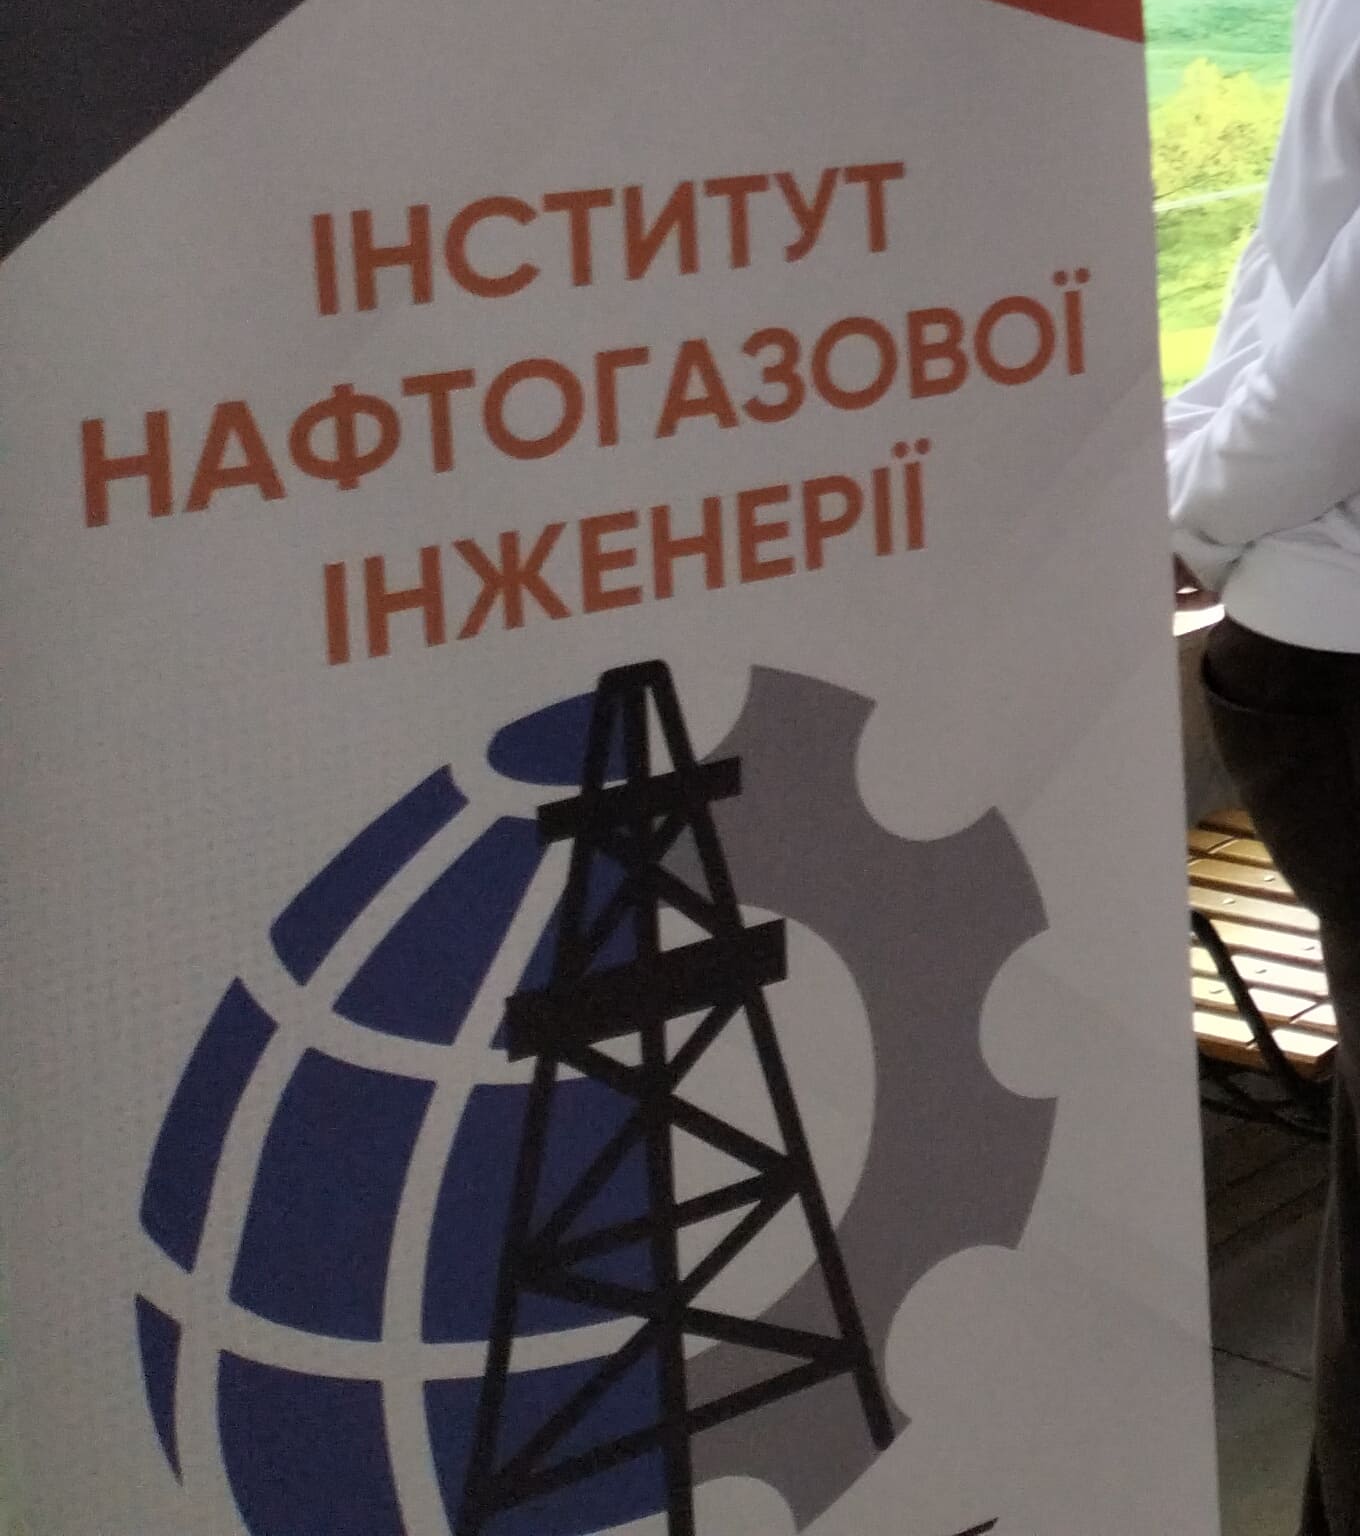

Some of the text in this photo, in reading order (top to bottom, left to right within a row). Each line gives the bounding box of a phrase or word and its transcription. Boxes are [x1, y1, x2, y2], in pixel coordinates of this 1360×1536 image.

[310, 161, 905, 317] ІНСТИТУТ
[80, 267, 1091, 528] НАФТОГАЗОВОЇ
[323, 437, 932, 666] ІНЖЕНЕРІЇ
